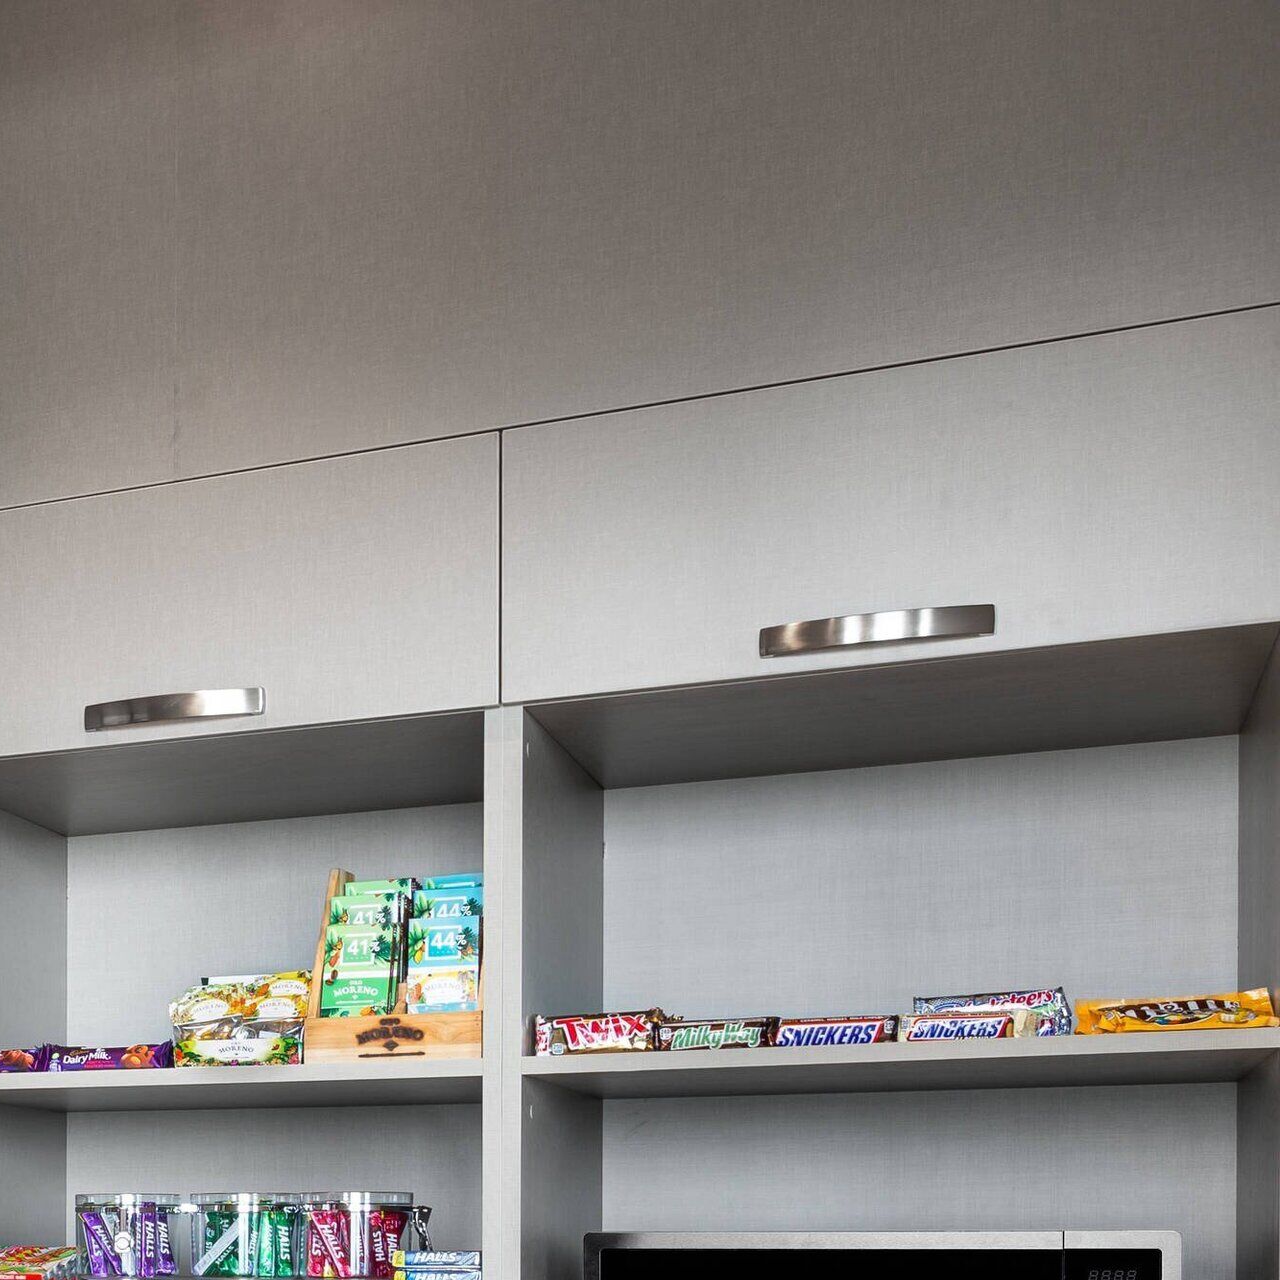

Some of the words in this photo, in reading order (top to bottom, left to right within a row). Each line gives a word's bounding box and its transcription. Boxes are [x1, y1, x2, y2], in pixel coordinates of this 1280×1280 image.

[346, 940, 381, 956] 41%
[430, 932, 467, 947] 44%
[332, 985, 379, 998] MORENO
[778, 1024, 879, 1047] SNICKERS
[913, 1019, 1003, 1039] SNICKERS
[63, 1054, 88, 1065] Dairy
[88, 1051, 111, 1061] Milk
[144, 1221, 155, 1258] HALLS
[157, 1221, 170, 1255] HALLS
[277, 1225, 291, 1260] HALLS
[321, 1223, 345, 1259] HALLS
[372, 1230, 386, 1262] HALLS
[414, 1252, 457, 1263] HALLS
